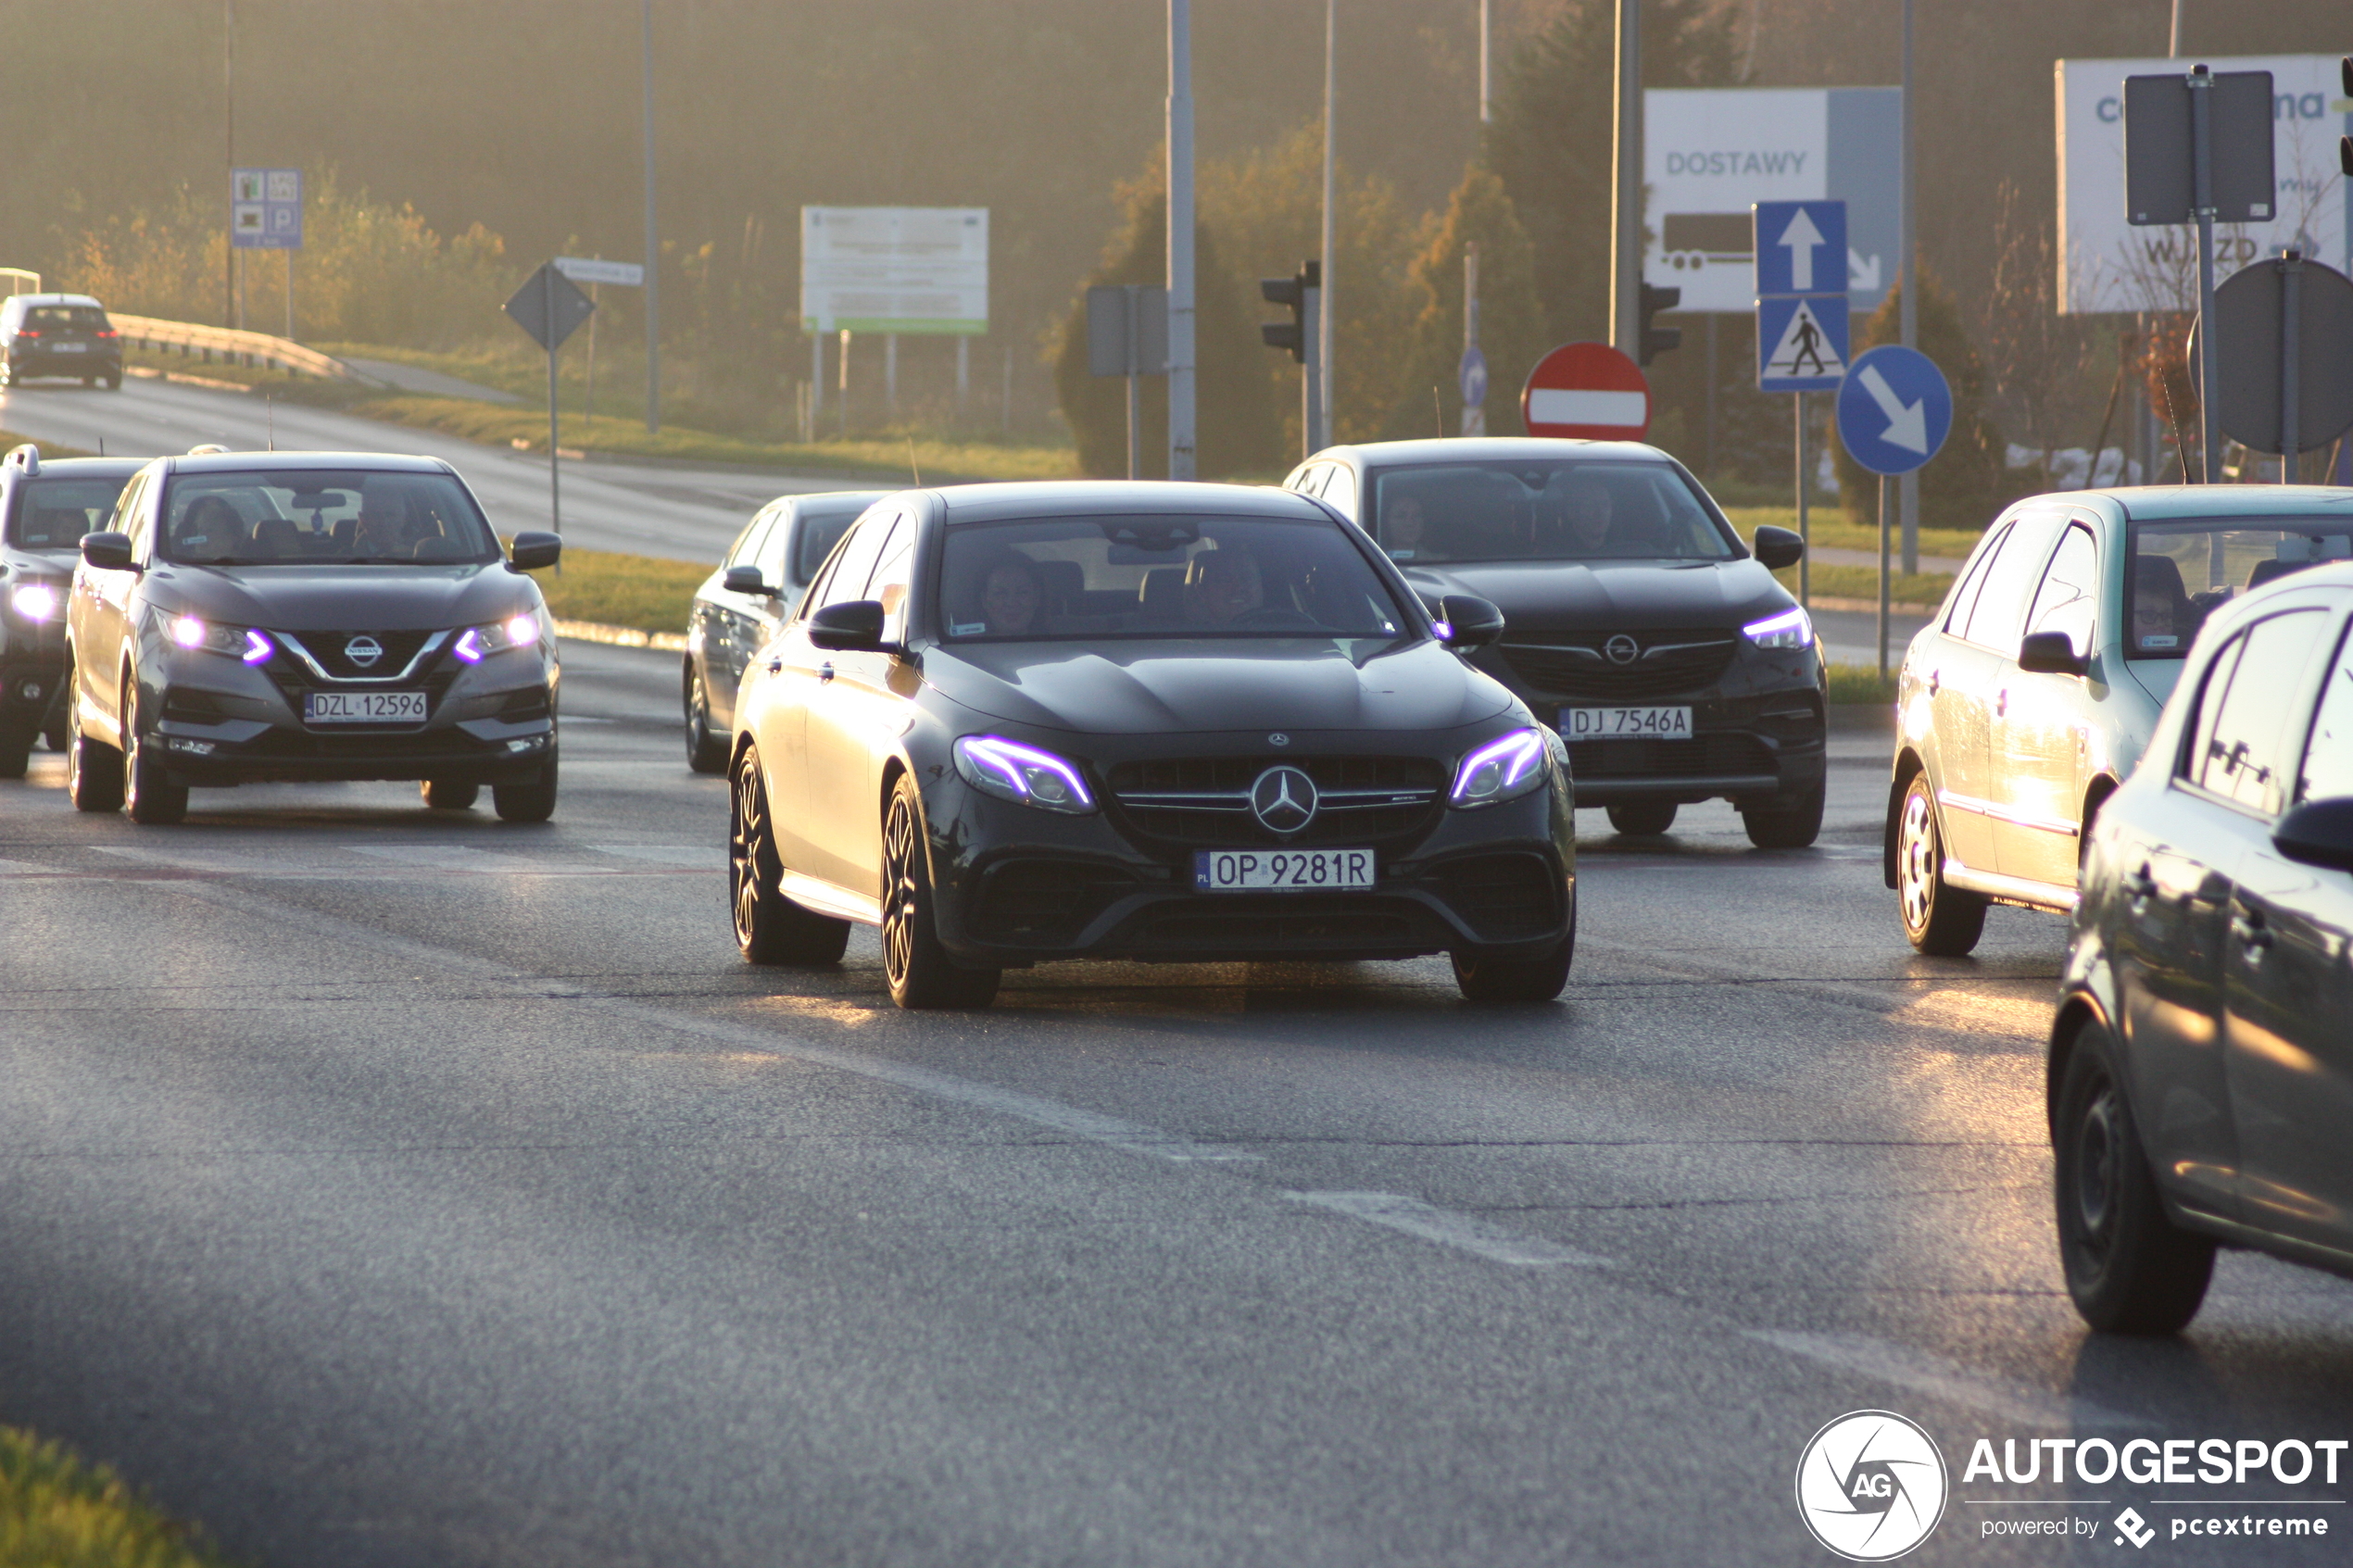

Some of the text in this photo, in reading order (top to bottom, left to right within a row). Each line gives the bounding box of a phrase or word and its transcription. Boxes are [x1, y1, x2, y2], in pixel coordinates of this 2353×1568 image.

[1667, 151, 1806, 175] DOSTAWY
[315, 696, 424, 716] DZL 12596
[1575, 709, 1686, 733] DJ 7546A
[1197, 874, 1209, 883] PL
[1217, 853, 1366, 884] OP 9281R
